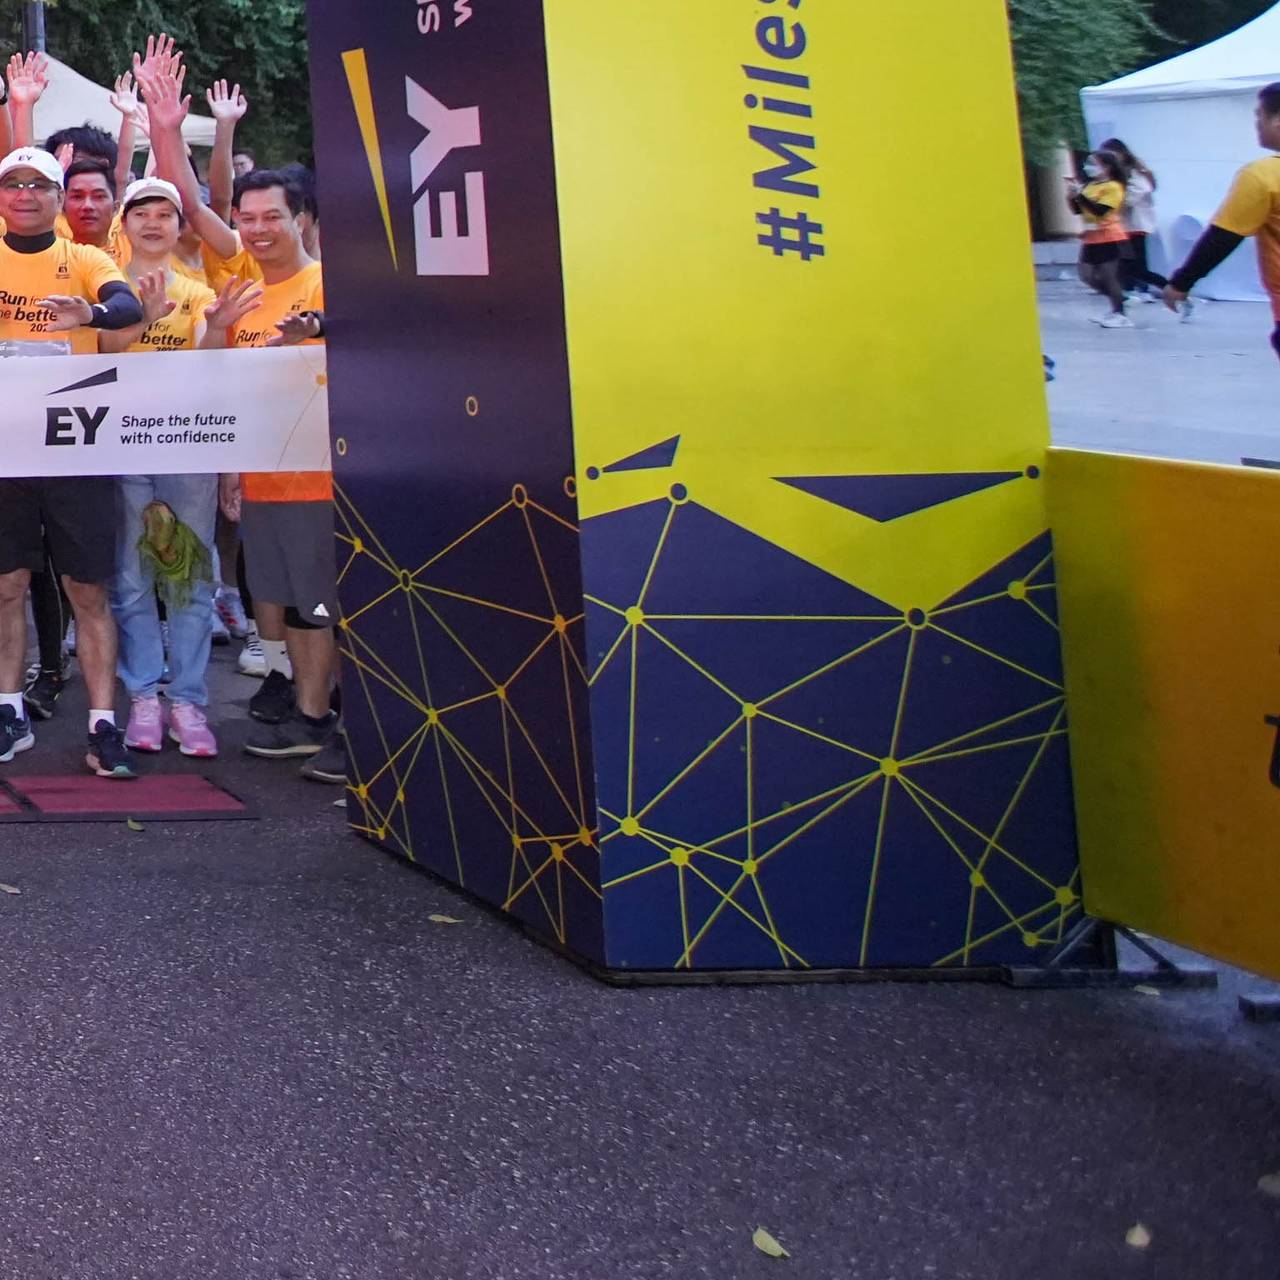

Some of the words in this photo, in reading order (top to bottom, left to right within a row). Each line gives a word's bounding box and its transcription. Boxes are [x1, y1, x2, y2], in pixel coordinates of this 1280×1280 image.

[405, 75, 490, 276] EY
[14, 308, 58, 321] bette
[30, 324, 48, 332] 202
[141, 332, 187, 346] better
[237, 330, 260, 343] Run
[45, 406, 109, 445] EY
[121, 414, 164, 430] Shape
[169, 413, 191, 426] the
[194, 413, 236, 426] future
[120, 432, 153, 444] with
[157, 429, 236, 444] confidence
